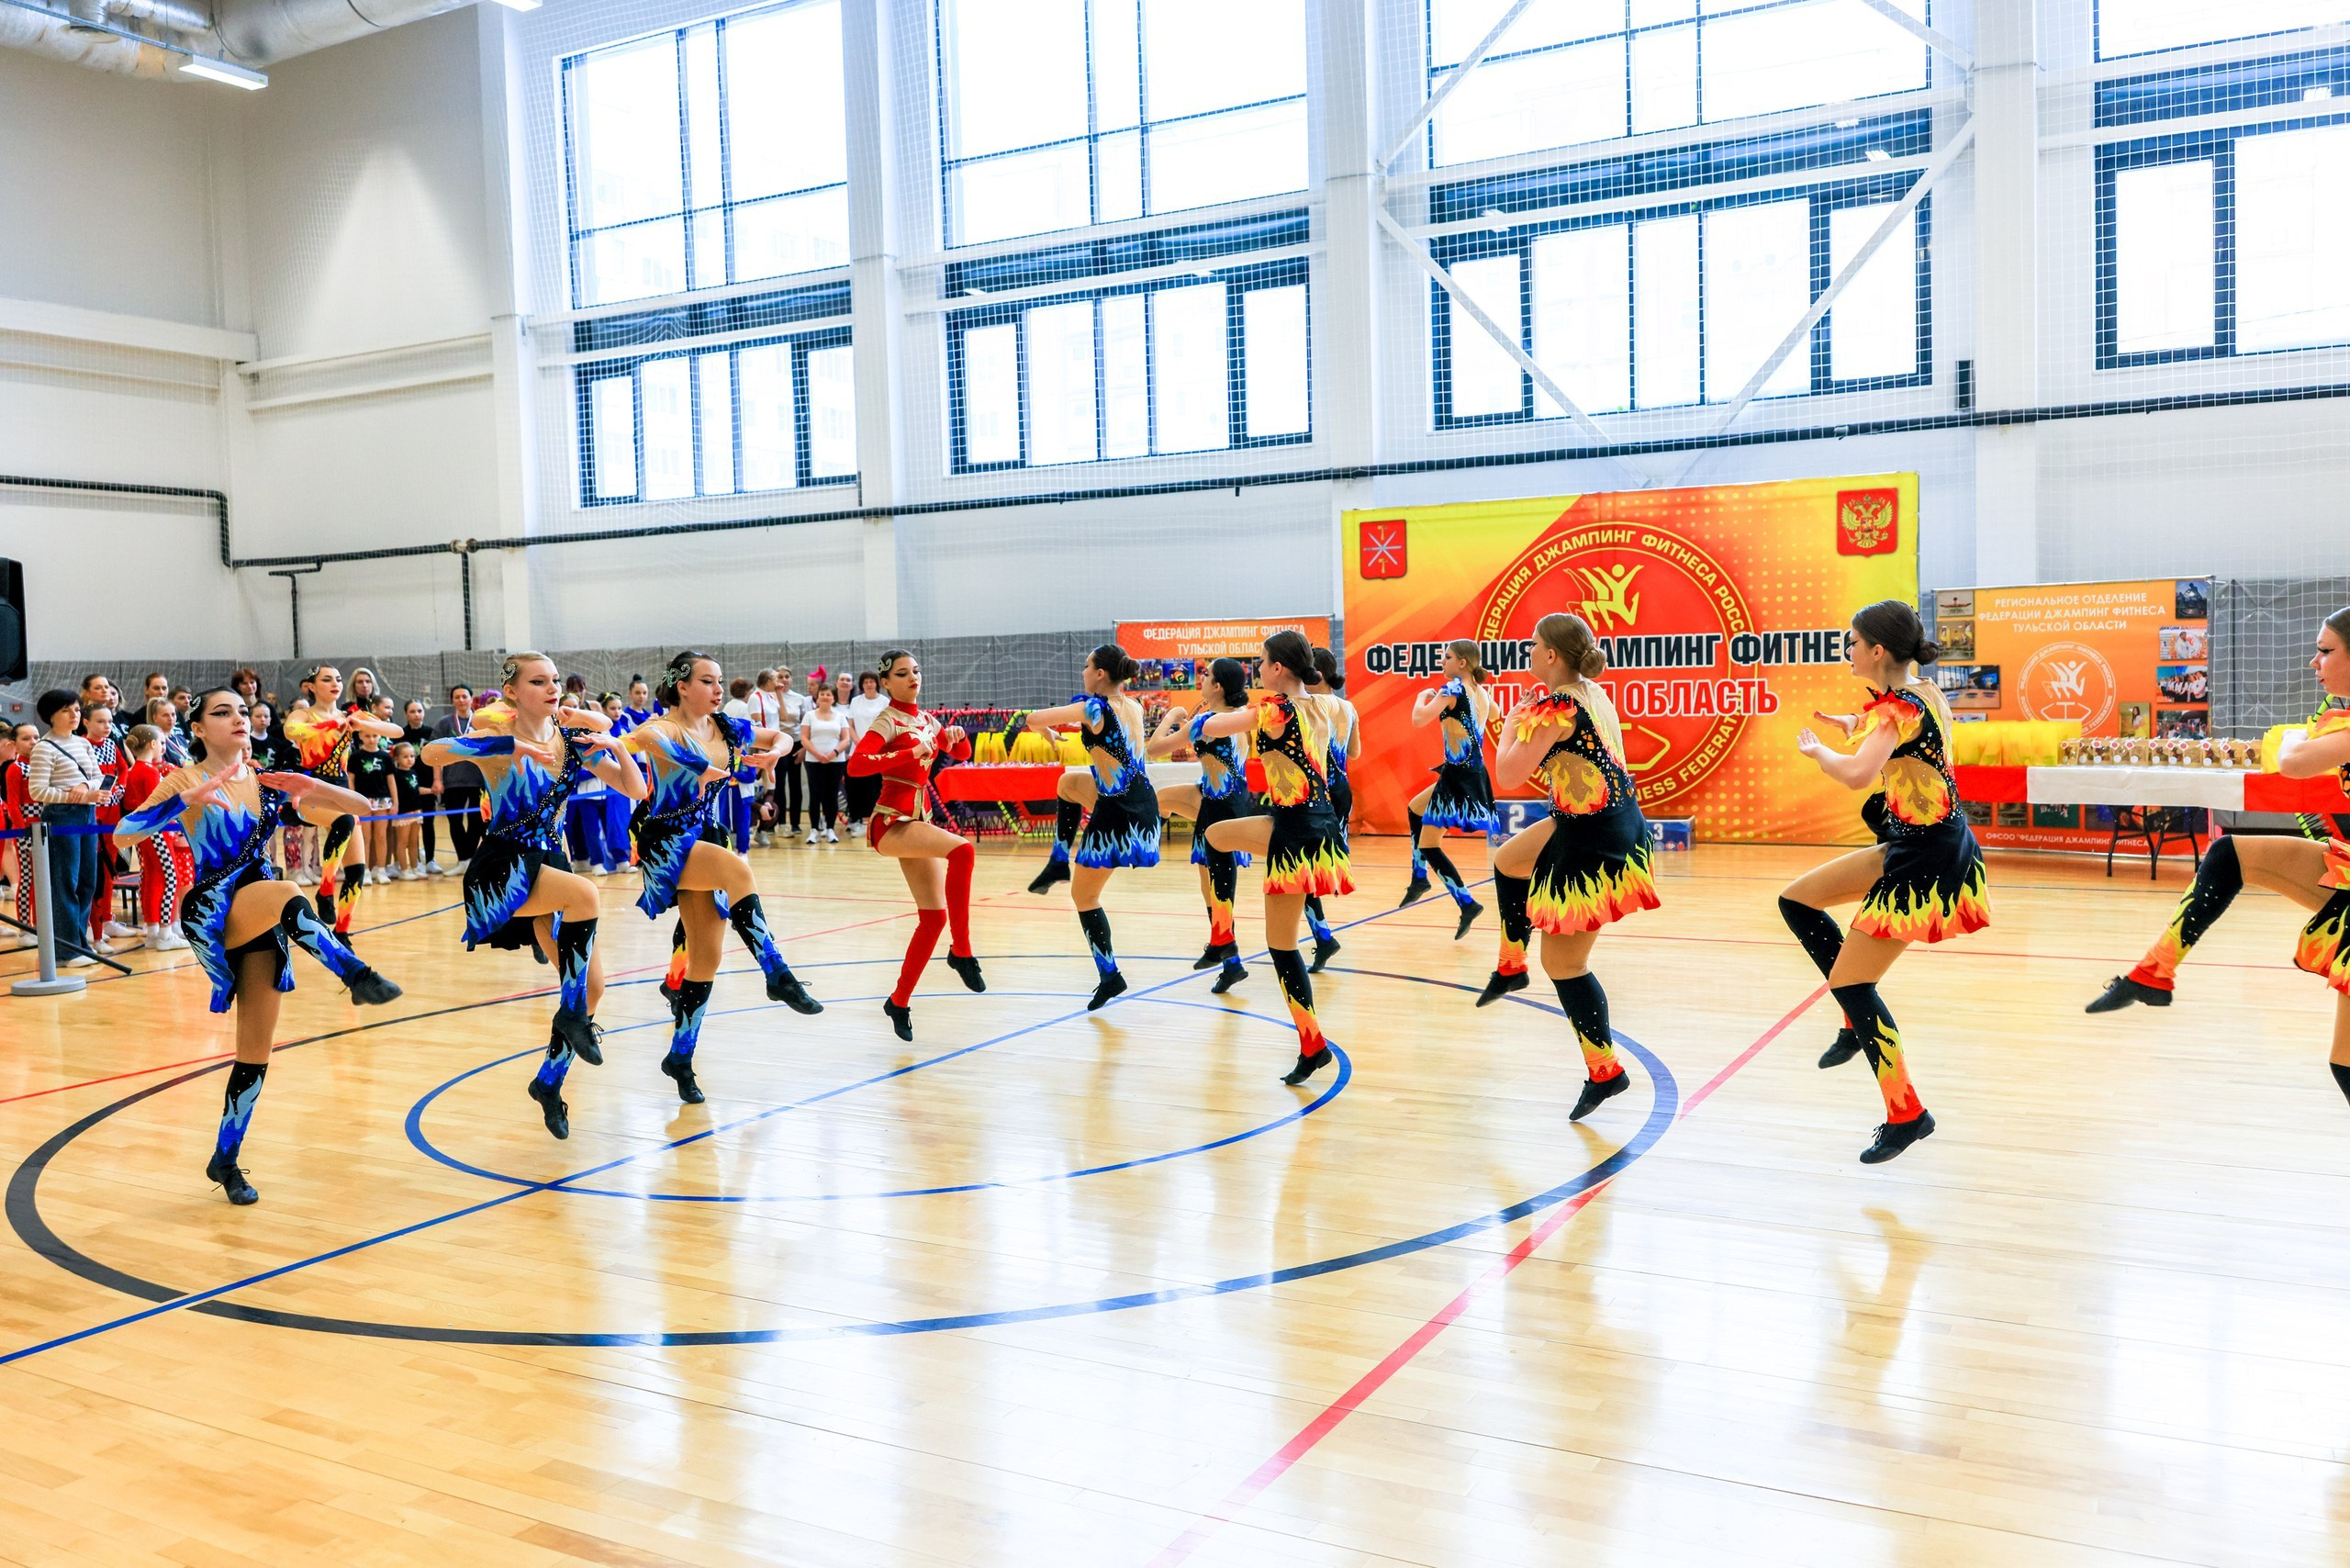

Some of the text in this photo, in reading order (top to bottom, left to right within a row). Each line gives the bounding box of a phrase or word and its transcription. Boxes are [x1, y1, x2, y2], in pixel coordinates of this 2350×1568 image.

[1483, 529, 1745, 641] ДЕРАЦИЯ ДЖАМПИНГ ФИТНЕСА РОСС
[1995, 592, 2147, 608] РЕГИОНАЛЬНОЕ ОТДЕЛЕНИЕ
[1977, 605, 2165, 622] ФЕДЕРАЦИИ ДЖАМПИНГ ФИТНЕСА
[1143, 628, 1201, 641] ФЕДЕРАЦИЯ
[1203, 626, 1258, 640] ДЖАМПИНГ
[2013, 619, 2127, 633] ТУЛЬСКОЙ ОБЛАСТИ
[1177, 641, 1265, 655] ТУЛЬСКОЙ ОБЛАСТ
[1366, 630, 1852, 678] ФЕДЕЦИЯ АМПИНГ ФИТНЕ
[1625, 679, 1779, 717] ОБЛАСТЬ
[1678, 700, 1742, 782] FEDERAT
[1508, 804, 1526, 834] 2
[1653, 823, 1664, 840] 3
[1986, 832, 2015, 841] ОФСОО
[2065, 836, 2110, 846] ДЖАМПИНГ
